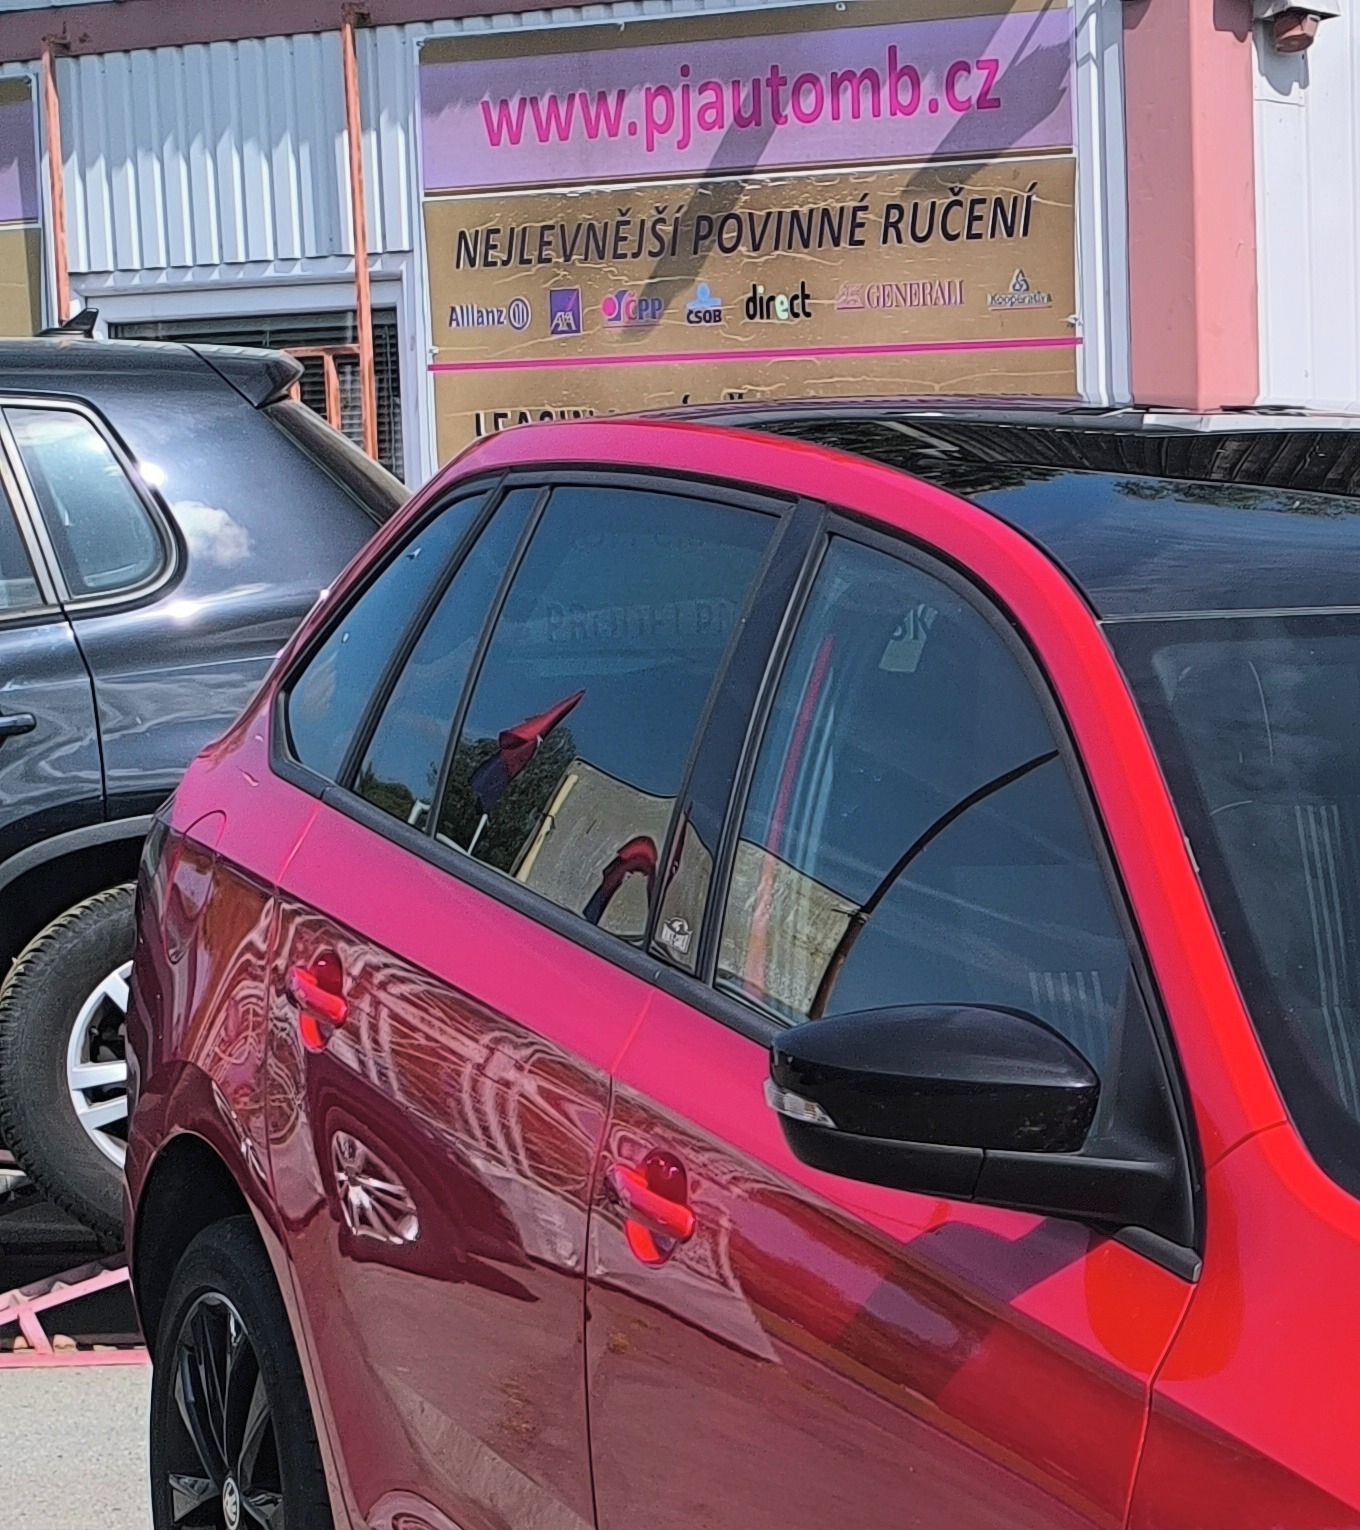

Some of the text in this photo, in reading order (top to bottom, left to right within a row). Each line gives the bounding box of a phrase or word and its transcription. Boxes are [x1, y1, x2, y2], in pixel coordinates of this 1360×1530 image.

[480, 44, 1001, 152] www.pjautomb.cz
[455, 182, 1038, 269] NEJLEVNĚJŠÍ POVINNÉ RUČENÍ
[745, 280, 813, 321] direct
[866, 279, 964, 309] GENERALI
[448, 303, 507, 328] Allianz
[550, 310, 578, 332] AXA
